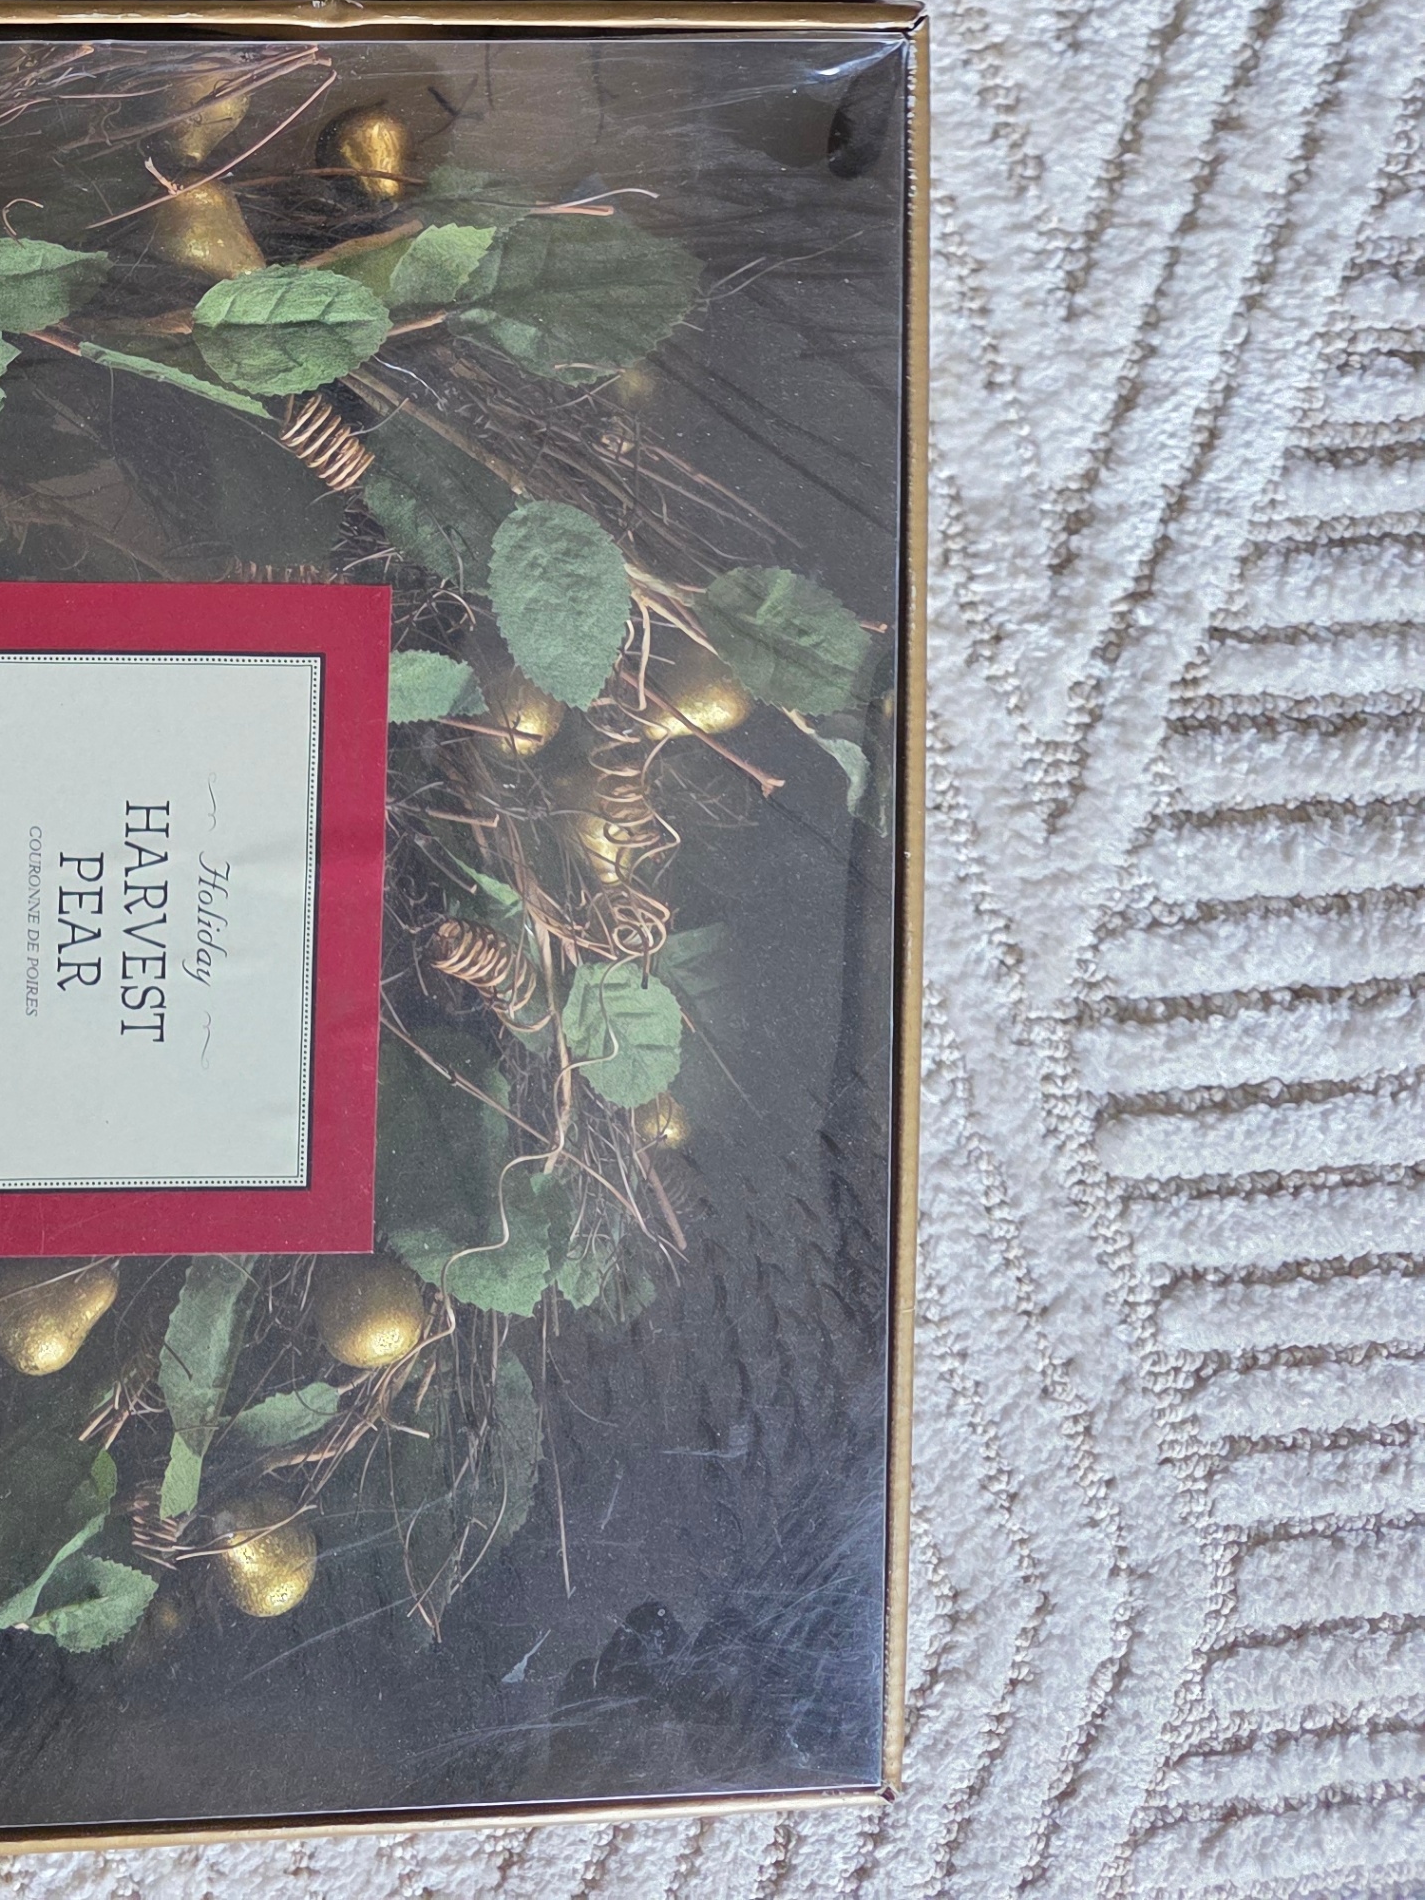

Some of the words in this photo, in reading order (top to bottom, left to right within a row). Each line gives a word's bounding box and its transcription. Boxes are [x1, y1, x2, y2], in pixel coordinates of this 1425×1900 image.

[28, 826, 42, 924] COURONNE
[57, 852, 104, 991] PEAR
[120, 800, 170, 1042] HARVEST
[182, 851, 230, 987] Holiday
[26, 957, 39, 1016] POIRES
[27, 929, 39, 952] DE
